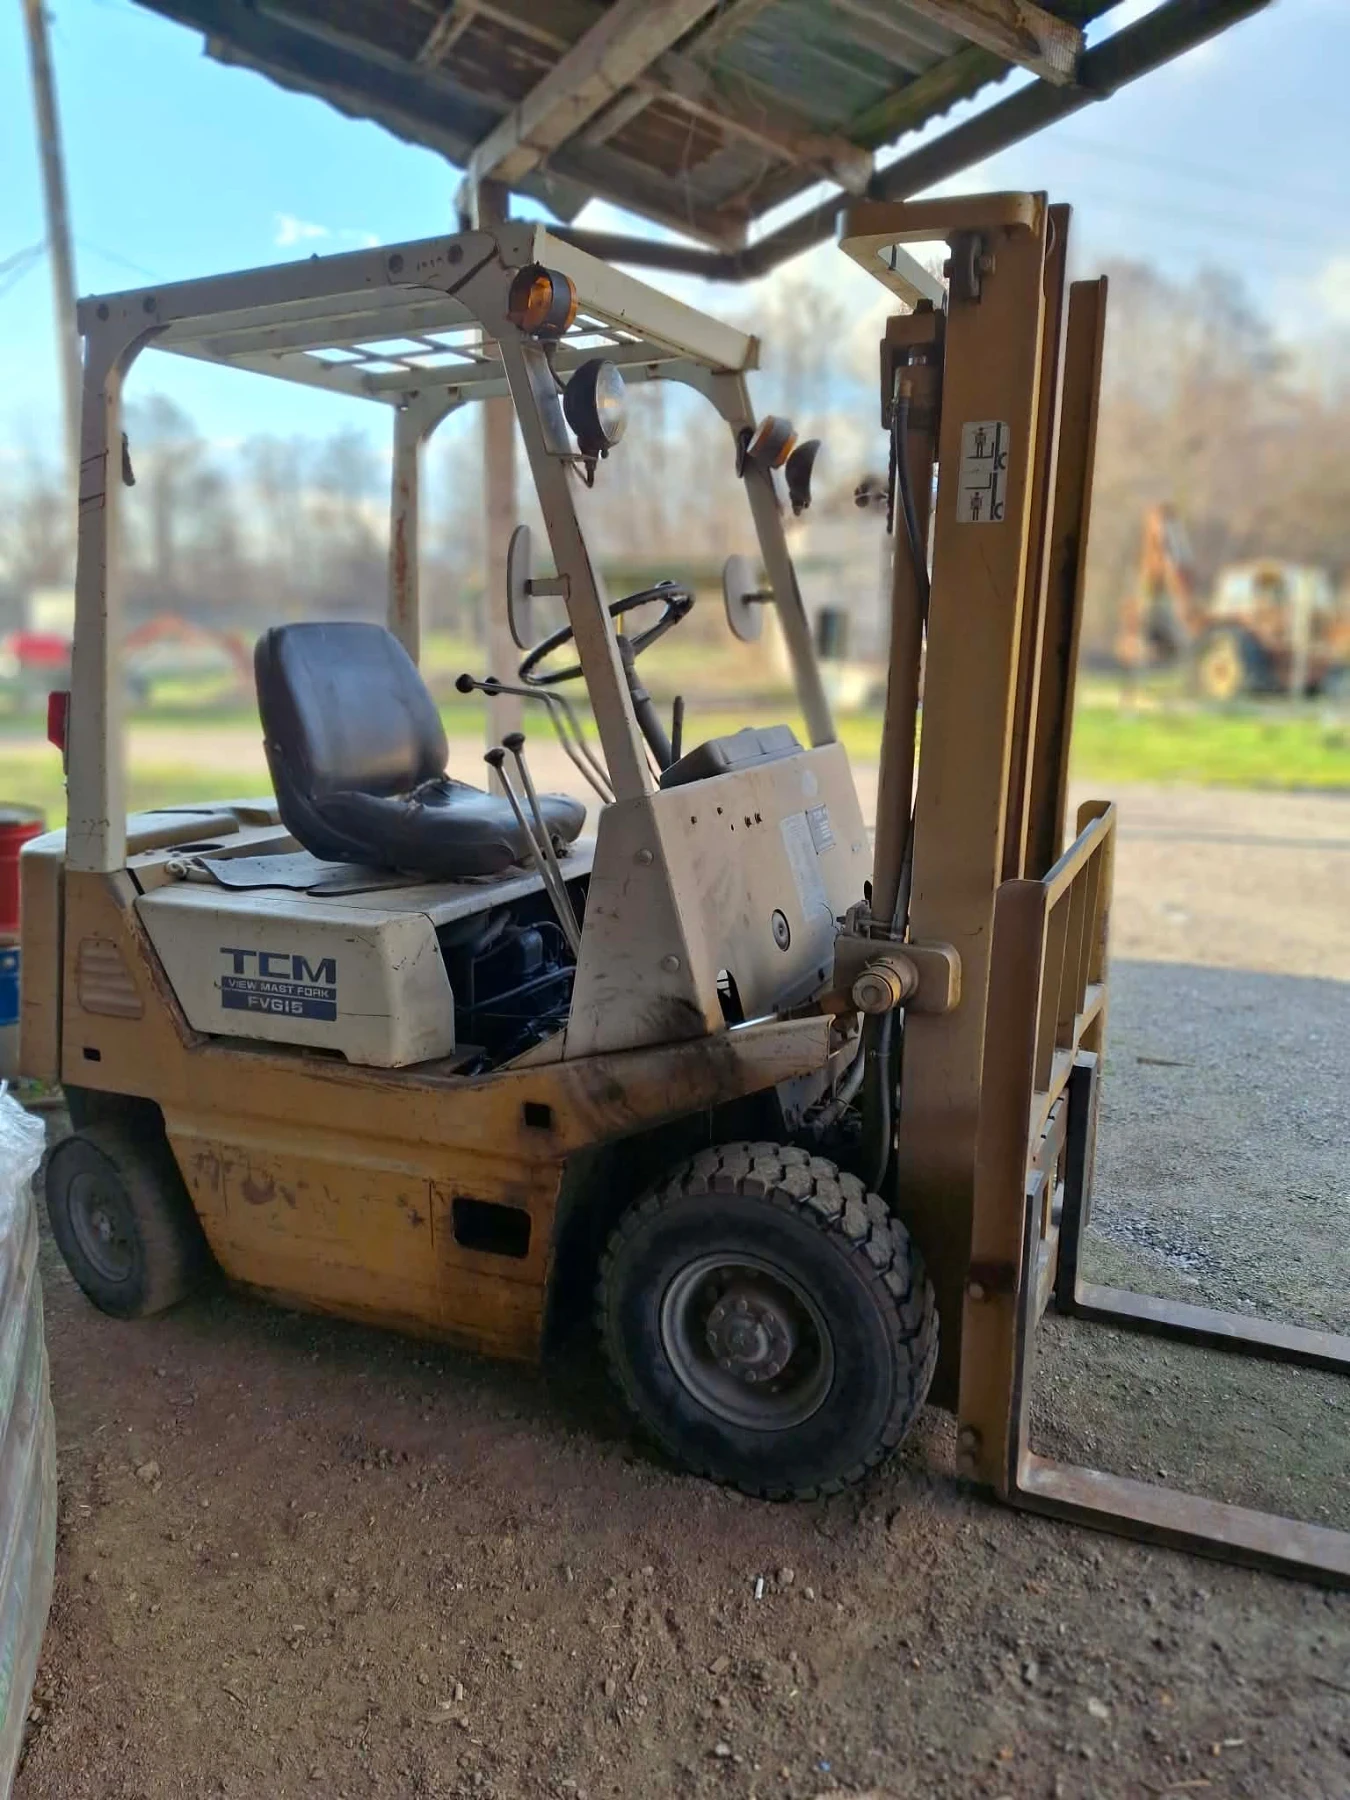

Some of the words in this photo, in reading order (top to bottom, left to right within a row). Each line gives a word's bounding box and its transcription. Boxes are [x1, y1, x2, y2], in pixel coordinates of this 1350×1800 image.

[220, 947, 337, 984] TCM
[228, 978, 256, 990] VIEW
[260, 982, 294, 994] MAST
[297, 986, 329, 998] FORK
